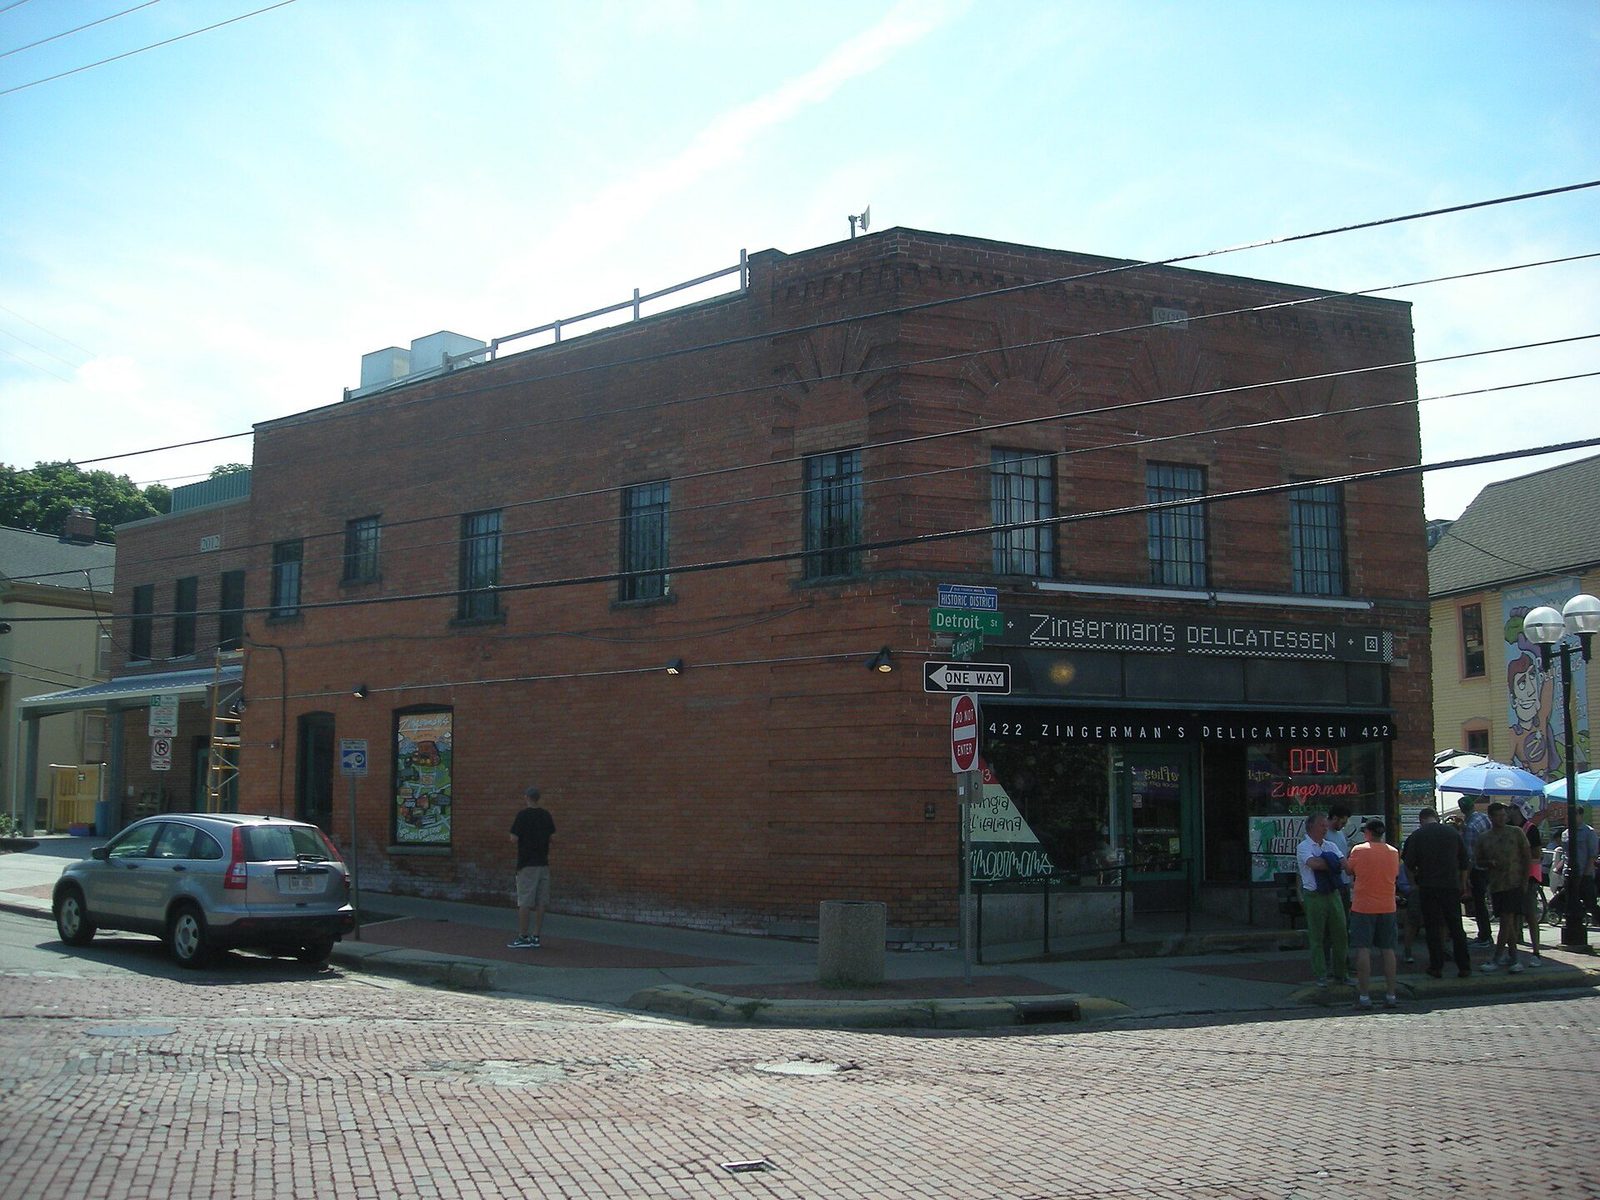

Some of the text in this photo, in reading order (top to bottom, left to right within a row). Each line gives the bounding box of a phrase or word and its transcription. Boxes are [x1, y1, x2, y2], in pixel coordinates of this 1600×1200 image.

[941, 593, 995, 608] HISTORIC DISTRICT
[936, 612, 979, 630] Detroit
[1029, 613, 1335, 651] Zingerman's DELICATESSEN
[944, 672, 1002, 685] ONE WAY
[956, 708, 974, 723] DO NOT
[989, 722, 1389, 739] 422 ZINGERMAN'S DELICATESSEN 422
[957, 743, 972, 757] ENTER
[1289, 747, 1339, 773] OPEN
